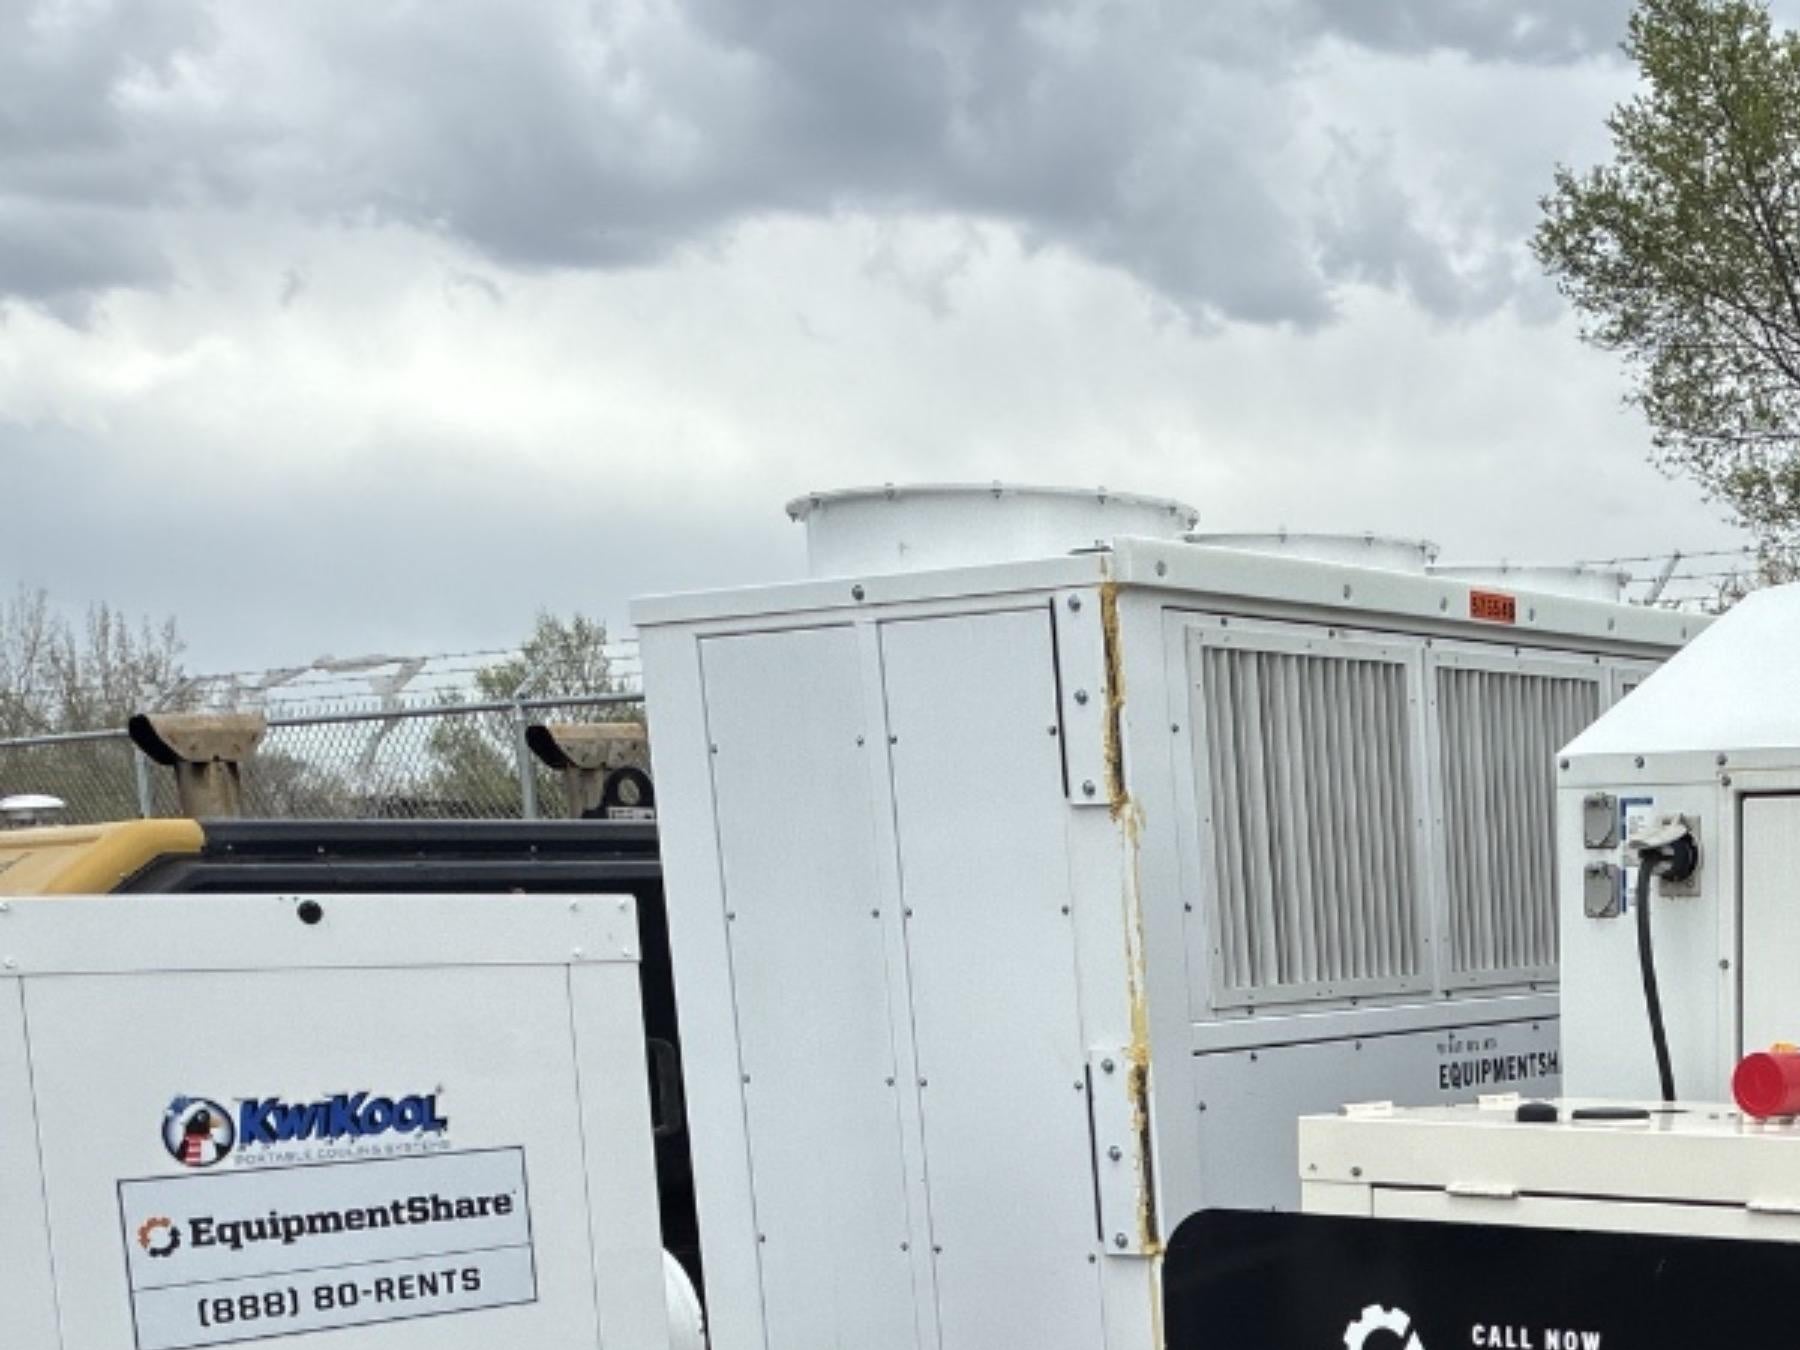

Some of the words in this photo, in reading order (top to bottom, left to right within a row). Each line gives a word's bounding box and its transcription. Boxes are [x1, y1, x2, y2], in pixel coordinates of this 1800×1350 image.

[1439, 1050, 1560, 1090] EQUIPMENTSH
[188, 1192, 514, 1250] EquipmentShare
[199, 1287, 299, 1327] (888)
[313, 1267, 482, 1311] 80-RENTS
[1471, 1324, 1533, 1350] CALL
